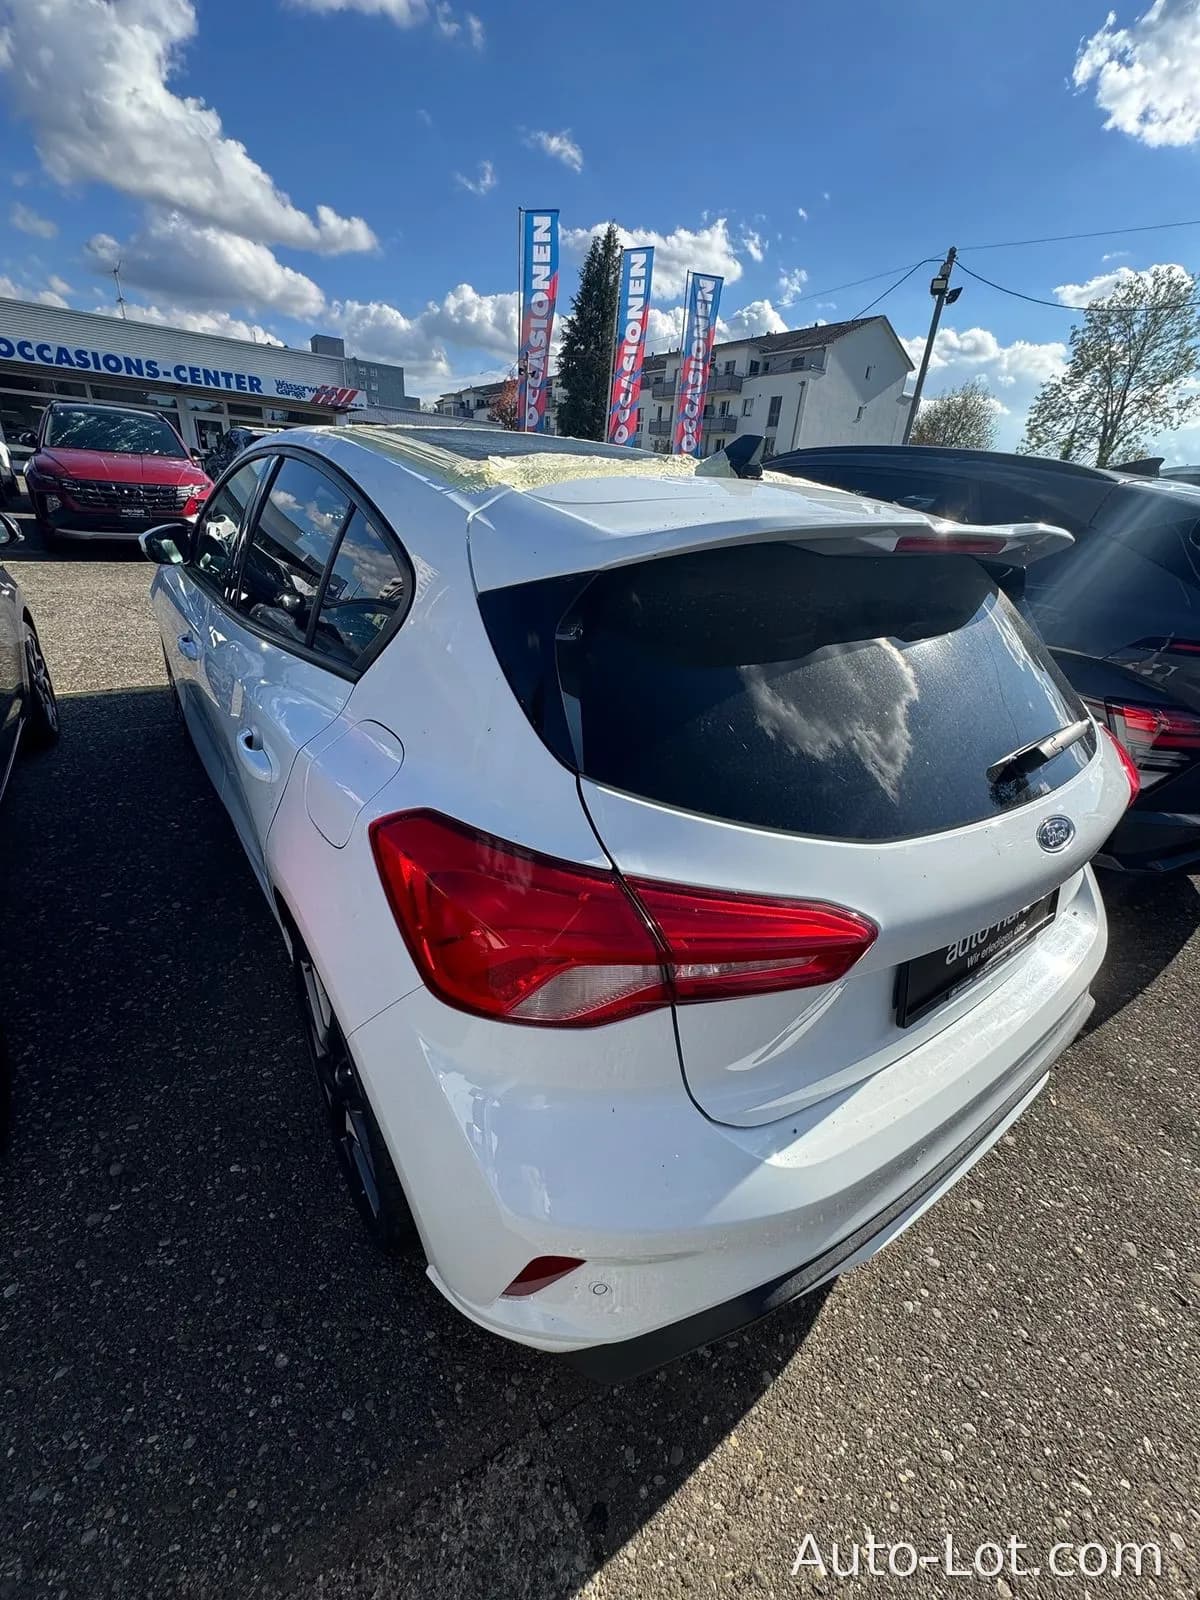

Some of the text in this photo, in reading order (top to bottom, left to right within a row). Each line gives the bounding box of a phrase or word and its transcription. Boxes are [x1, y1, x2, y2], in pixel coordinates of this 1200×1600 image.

[0, 337, 263, 394] OCCASIONS-CENTER
[527, 215, 552, 427] OCCASIONEN
[614, 253, 647, 444] OCCASIONEN
[681, 278, 716, 452] OCCASIONEN
[276, 387, 306, 399] Garage
[967, 952, 980, 968] Wir
